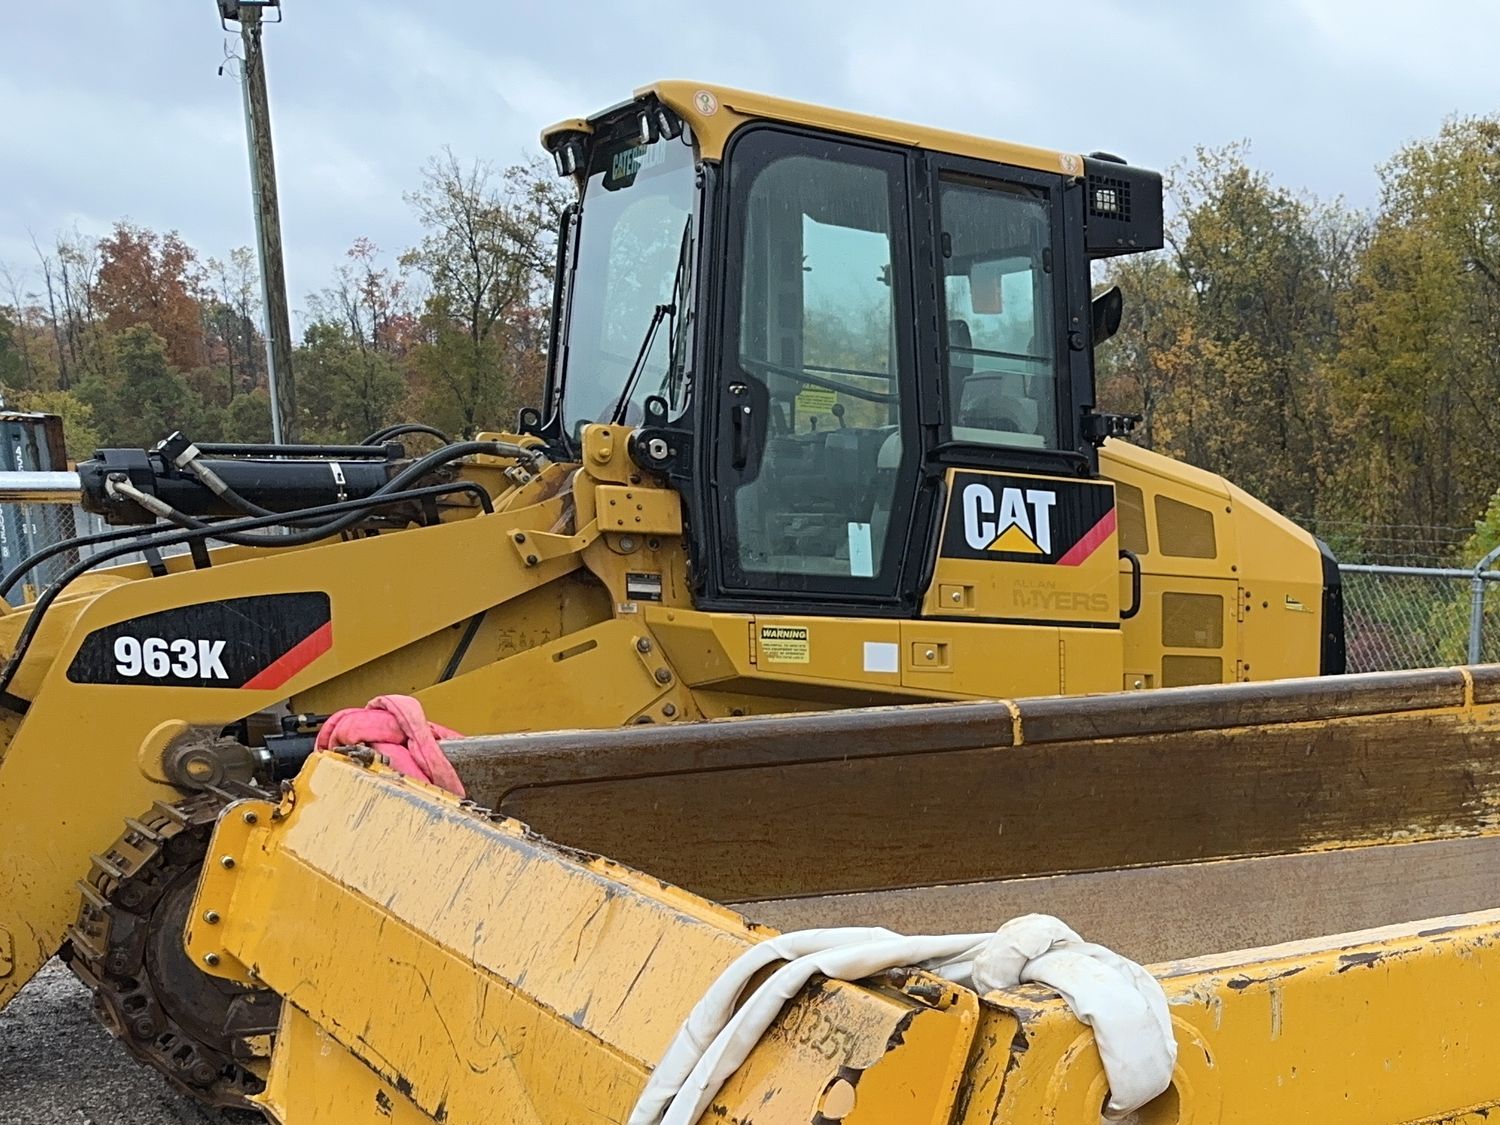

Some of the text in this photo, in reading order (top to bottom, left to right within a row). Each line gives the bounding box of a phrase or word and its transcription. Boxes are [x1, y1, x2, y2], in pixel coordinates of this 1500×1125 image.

[963, 483, 1056, 555] CAT
[763, 629, 807, 639] WARNING
[114, 636, 229, 680] 963K
